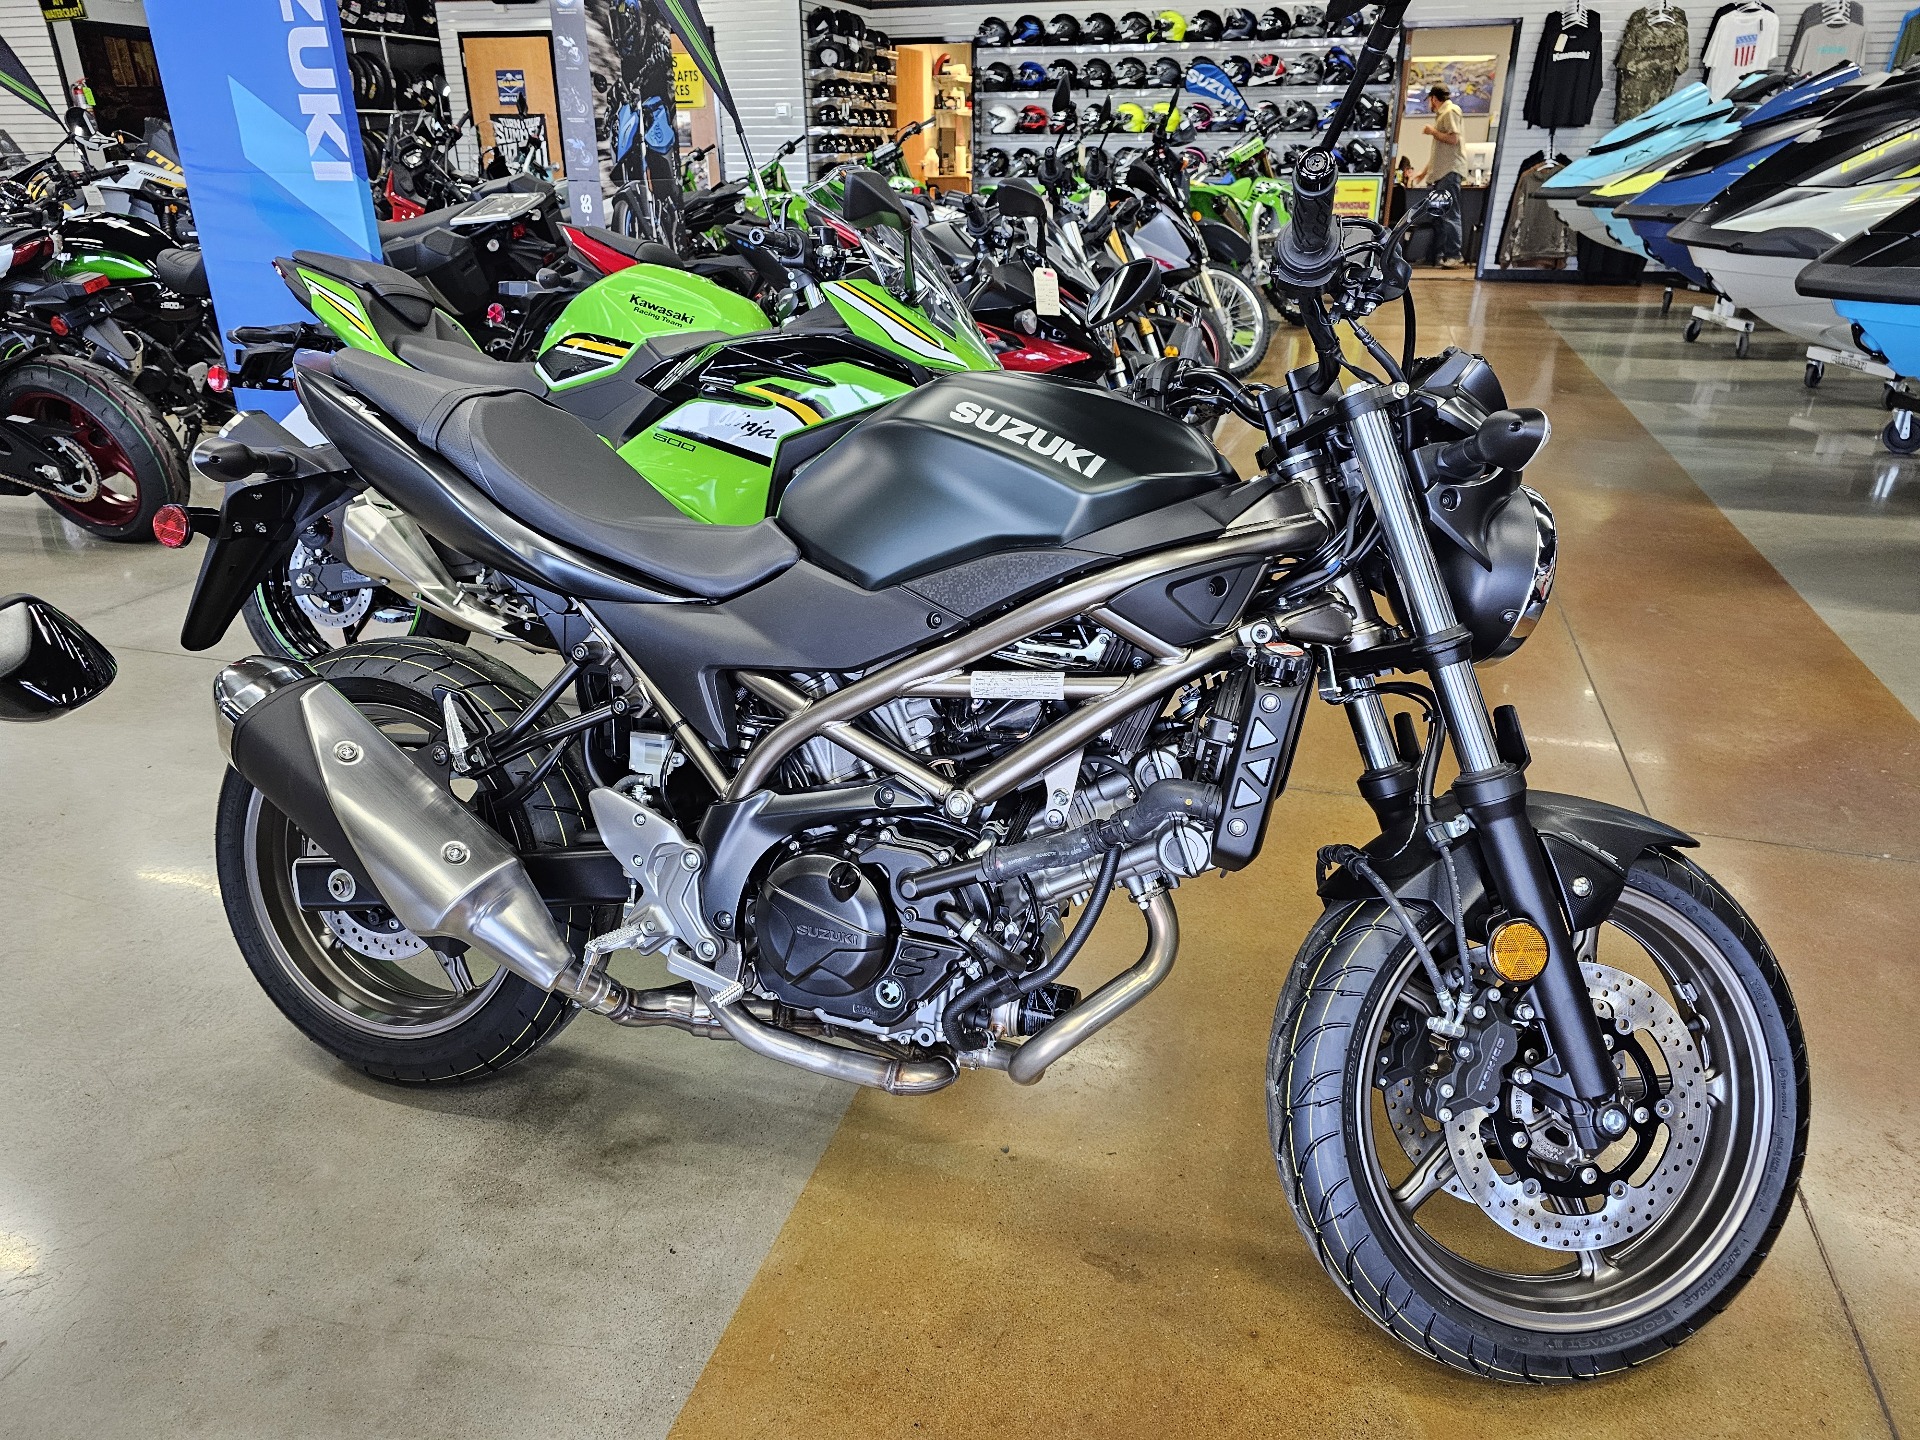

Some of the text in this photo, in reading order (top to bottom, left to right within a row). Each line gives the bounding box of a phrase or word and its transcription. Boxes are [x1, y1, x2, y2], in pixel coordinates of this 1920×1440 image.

[1187, 69, 1245, 109] SUZUKI
[629, 293, 696, 325] Kawasaki
[633, 306, 683, 328] Racing Team
[718, 411, 778, 440] Ninja
[950, 401, 1107, 479] SUZUKI
[653, 433, 697, 453] 500
[796, 925, 860, 946] SUZUKI
[1478, 1037, 1505, 1092] TOKICO
